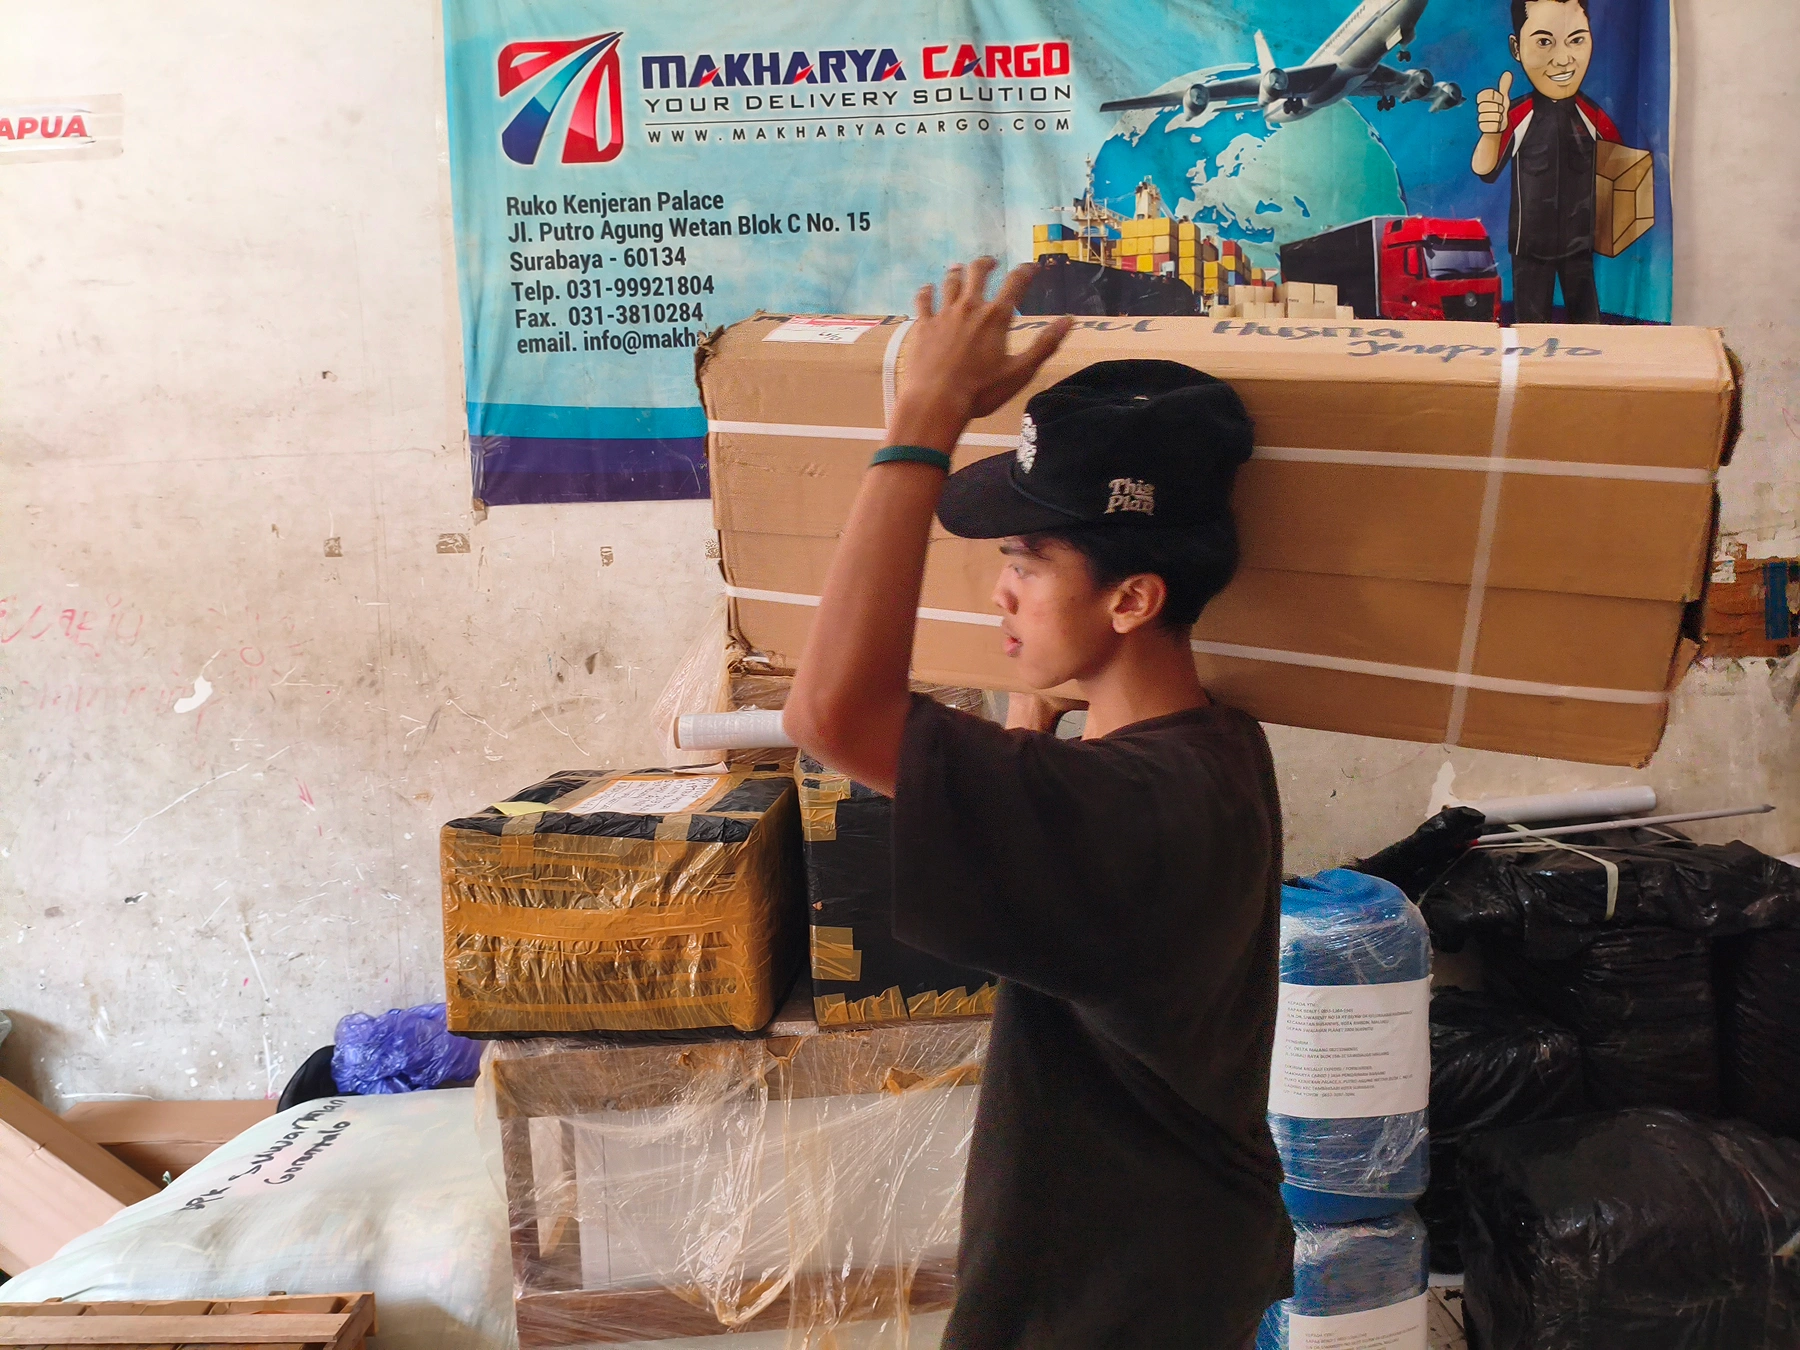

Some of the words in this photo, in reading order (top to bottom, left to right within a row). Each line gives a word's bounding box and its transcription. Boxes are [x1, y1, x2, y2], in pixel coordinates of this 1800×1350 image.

[641, 48, 907, 89] MAKHARYA
[922, 42, 1070, 80] CARGO
[644, 96, 730, 113] YOUR
[745, 91, 898, 110] DELIVERY
[913, 84, 1071, 104] SOLUTION
[506, 195, 557, 216] Ruko
[563, 192, 651, 219] Kenjeran
[657, 190, 724, 212] Palace
[508, 221, 533, 243] Jl.
[539, 222, 595, 242] Putro
[600, 220, 664, 244] Agung
[669, 217, 732, 238] Wetan
[737, 213, 783, 236] Blok
[787, 213, 801, 234] C
[806, 213, 840, 233] No.
[846, 211, 871, 232] 15
[510, 249, 603, 274] Surabaya
[623, 246, 687, 268] 60134
[511, 280, 560, 305] Telp.
[566, 275, 715, 300] 031-99921804
[515, 308, 557, 329] Fax.
[568, 302, 704, 326] 031-3810284
[517, 331, 577, 354] email.
[1108, 478, 1155, 495] This
